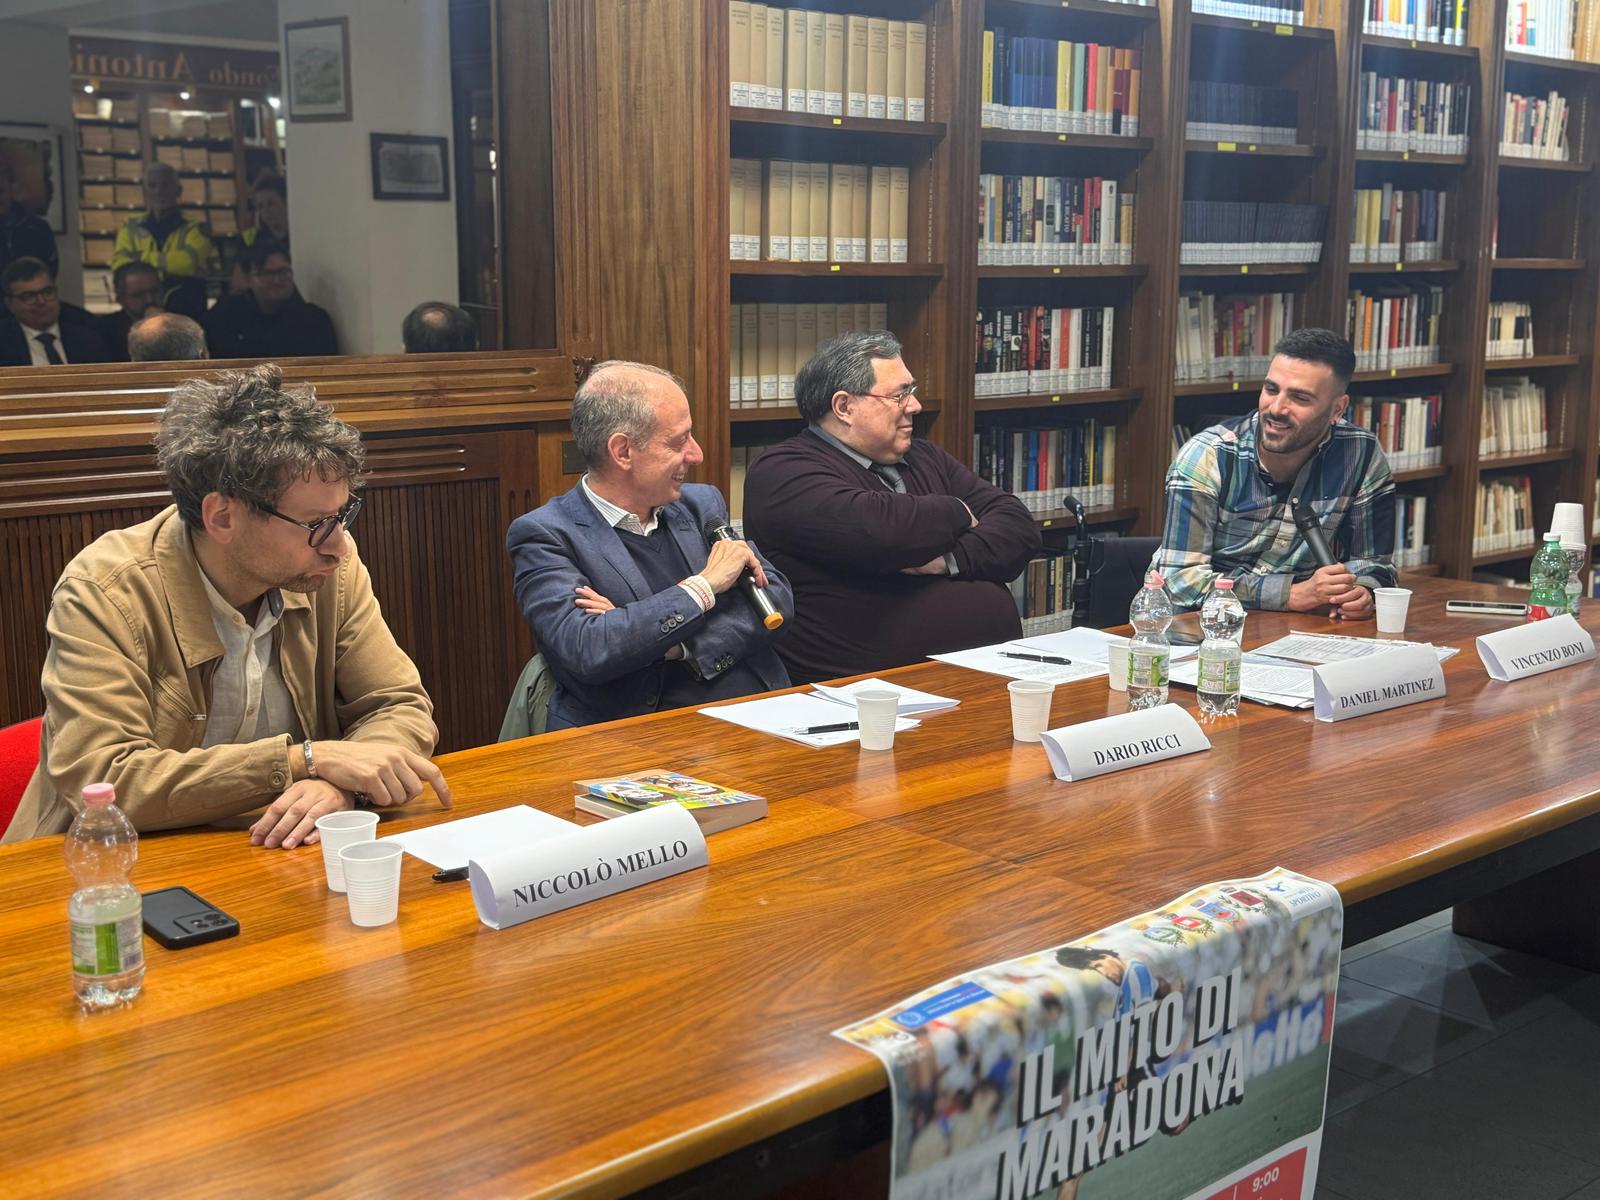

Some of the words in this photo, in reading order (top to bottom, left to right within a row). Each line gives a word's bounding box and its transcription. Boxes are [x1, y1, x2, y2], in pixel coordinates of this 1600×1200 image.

[1511, 647, 1561, 671] VINCENZO
[1561, 642, 1586, 659] BONI
[1340, 689, 1380, 709] DANIEL
[1382, 678, 1435, 701] MARTINEZ
[1093, 742, 1140, 766] DARIO
[1140, 733, 1182, 755] RICCI
[512, 857, 612, 908] NICCOLÒ
[616, 840, 688, 876] MELLO
[1018, 1044, 1062, 1126] IL
[1073, 990, 1182, 1100] MITO
[1194, 966, 1242, 1047] DI
[997, 1036, 1244, 1200] MARADONA
[1252, 1166, 1280, 1193] 9:00
